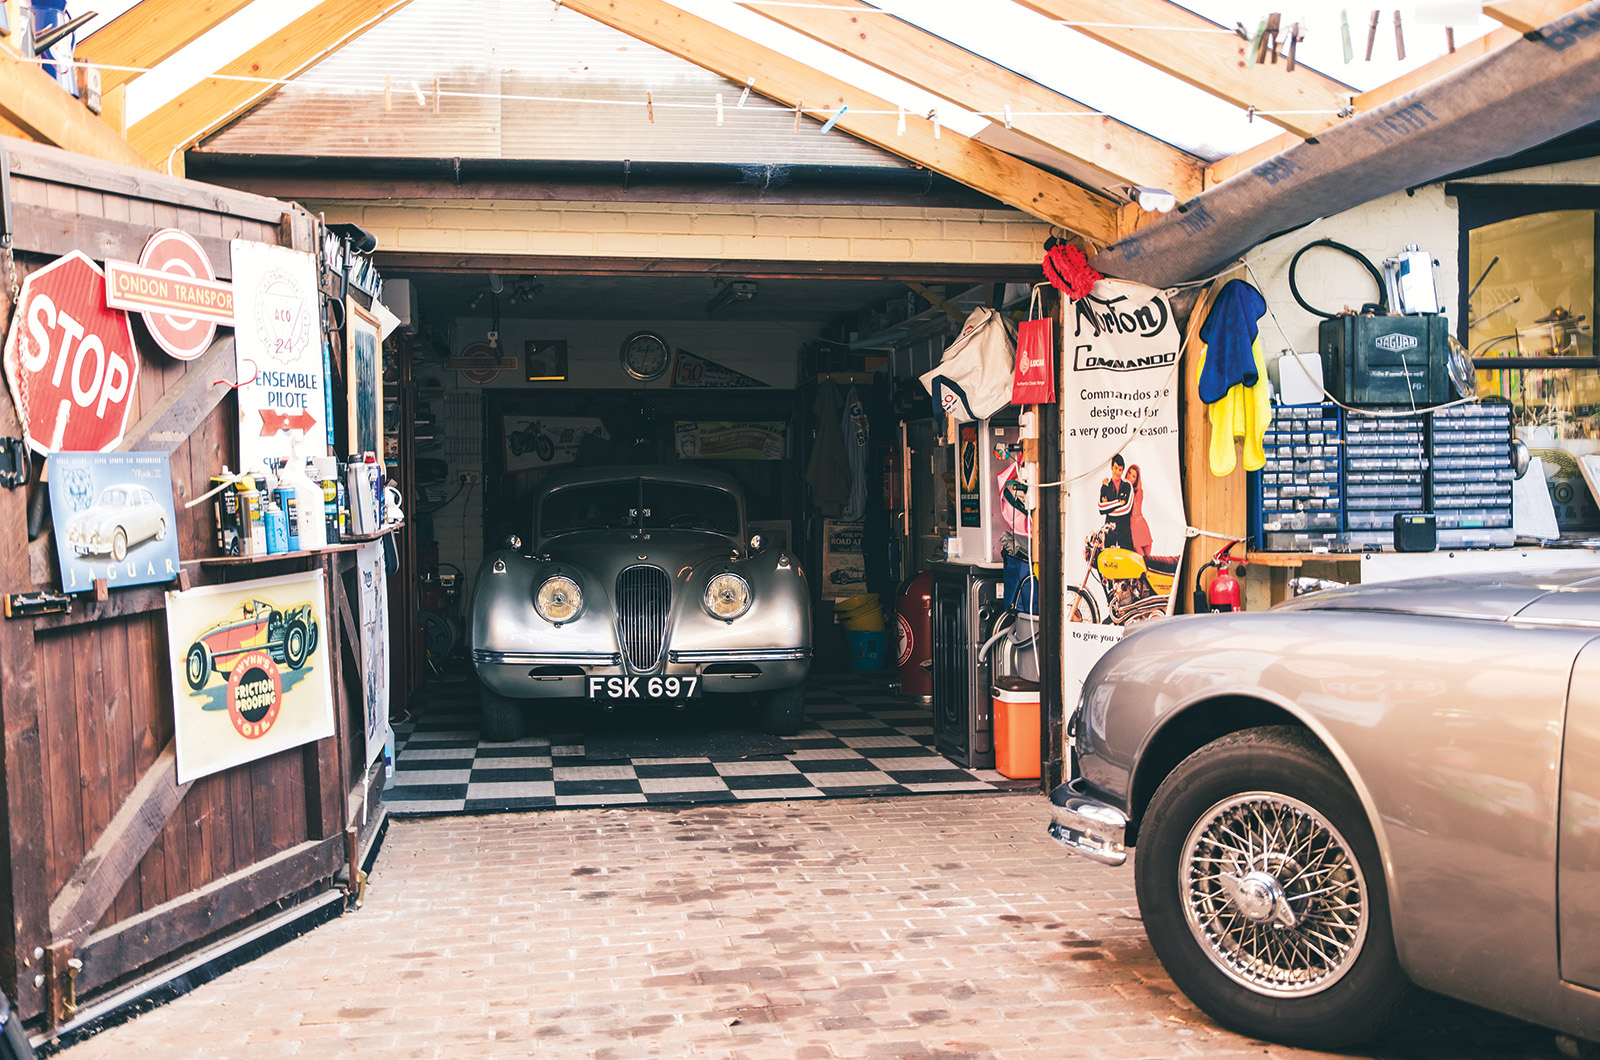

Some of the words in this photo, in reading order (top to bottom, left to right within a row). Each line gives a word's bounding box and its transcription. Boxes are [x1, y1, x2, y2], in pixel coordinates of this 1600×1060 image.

[1364, 100, 1440, 145] LIGHT
[112, 269, 168, 298] LONDON
[274, 309, 291, 322] ACO
[1070, 294, 1168, 338] Norton
[275, 338, 293, 354] 24
[1376, 335, 1417, 350] JAGUAR
[23, 294, 130, 420] STOP
[1030, 358, 1045, 367] LUCAS
[255, 370, 318, 389] ENSEMBLE
[268, 391, 308, 408] PILOTE
[1080, 388, 1151, 401] Commandos
[1090, 405, 1141, 420] designed
[1070, 428, 1077, 436] a
[1079, 426, 1099, 438] very
[1101, 423, 1128, 439] good
[69, 558, 175, 587] JAGUAR
[1072, 630, 1081, 639] to
[1083, 630, 1098, 643] give
[1100, 634, 1114, 643] you
[236, 654, 270, 675] WYNN'S
[234, 679, 275, 700] FRICTION
[589, 676, 640, 698] FSK
[647, 676, 698, 698] 697
[235, 691, 276, 713] PROOFING
[242, 719, 271, 737] OIL
